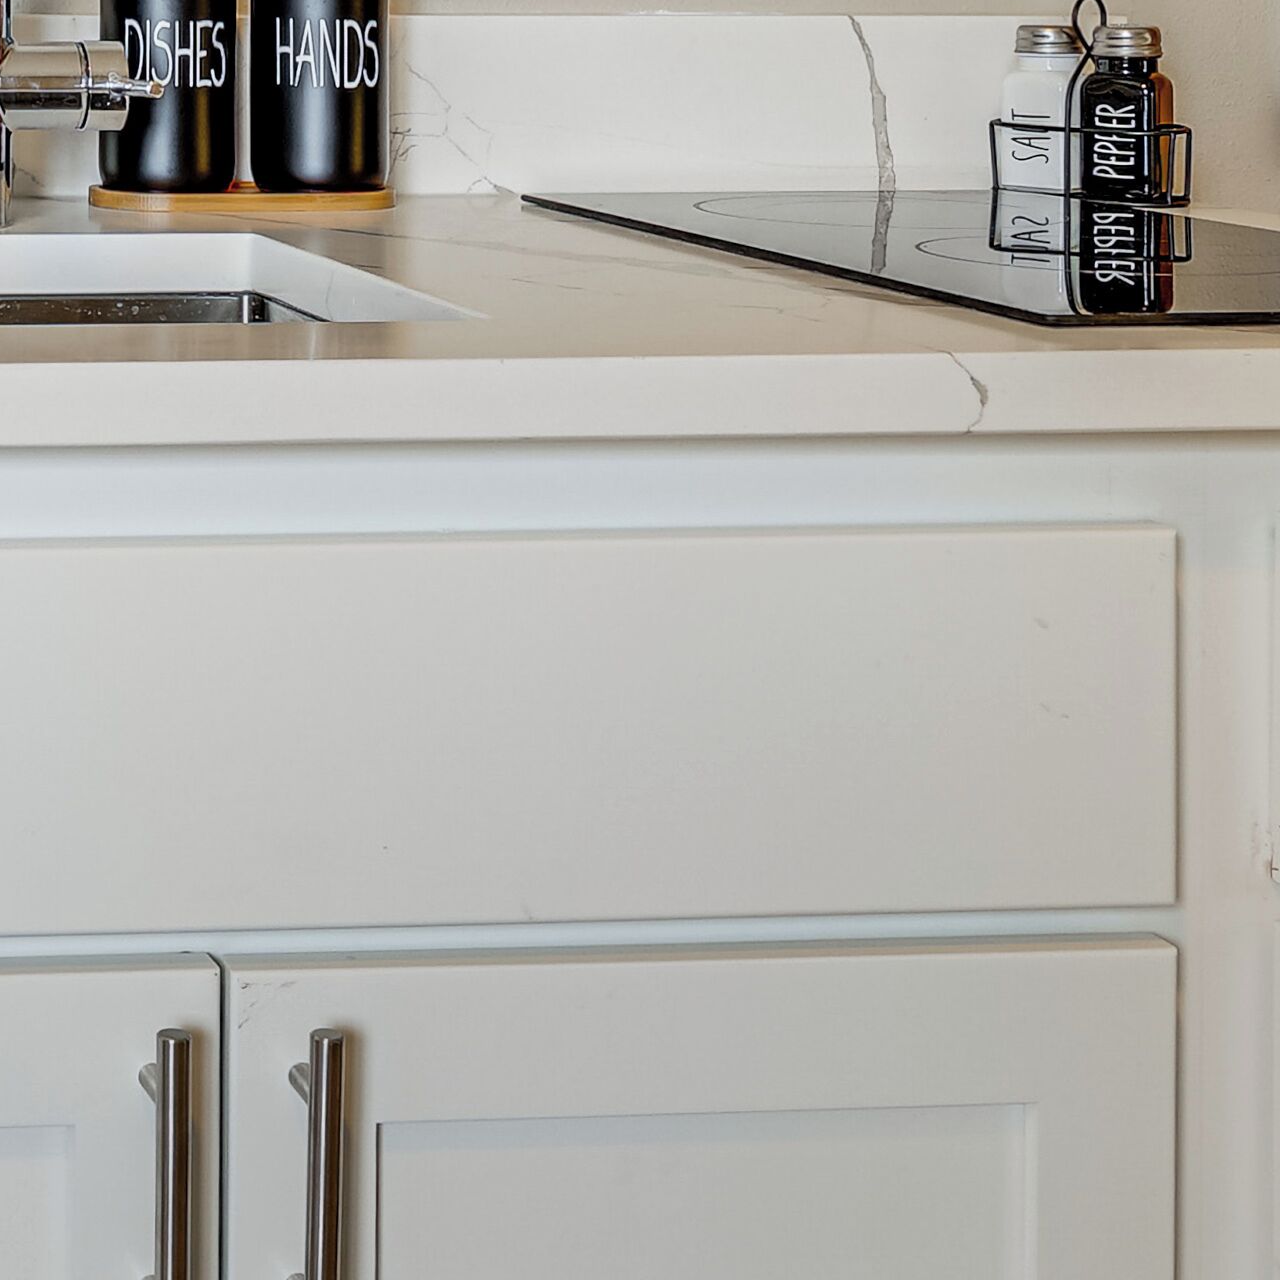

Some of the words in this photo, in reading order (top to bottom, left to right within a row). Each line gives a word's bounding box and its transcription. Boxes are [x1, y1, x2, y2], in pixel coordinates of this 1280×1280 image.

[124, 18, 227, 87] DISHES
[275, 17, 379, 89] HANDS
[1011, 108, 1051, 164] SALT
[1092, 103, 1136, 180] PEPPER
